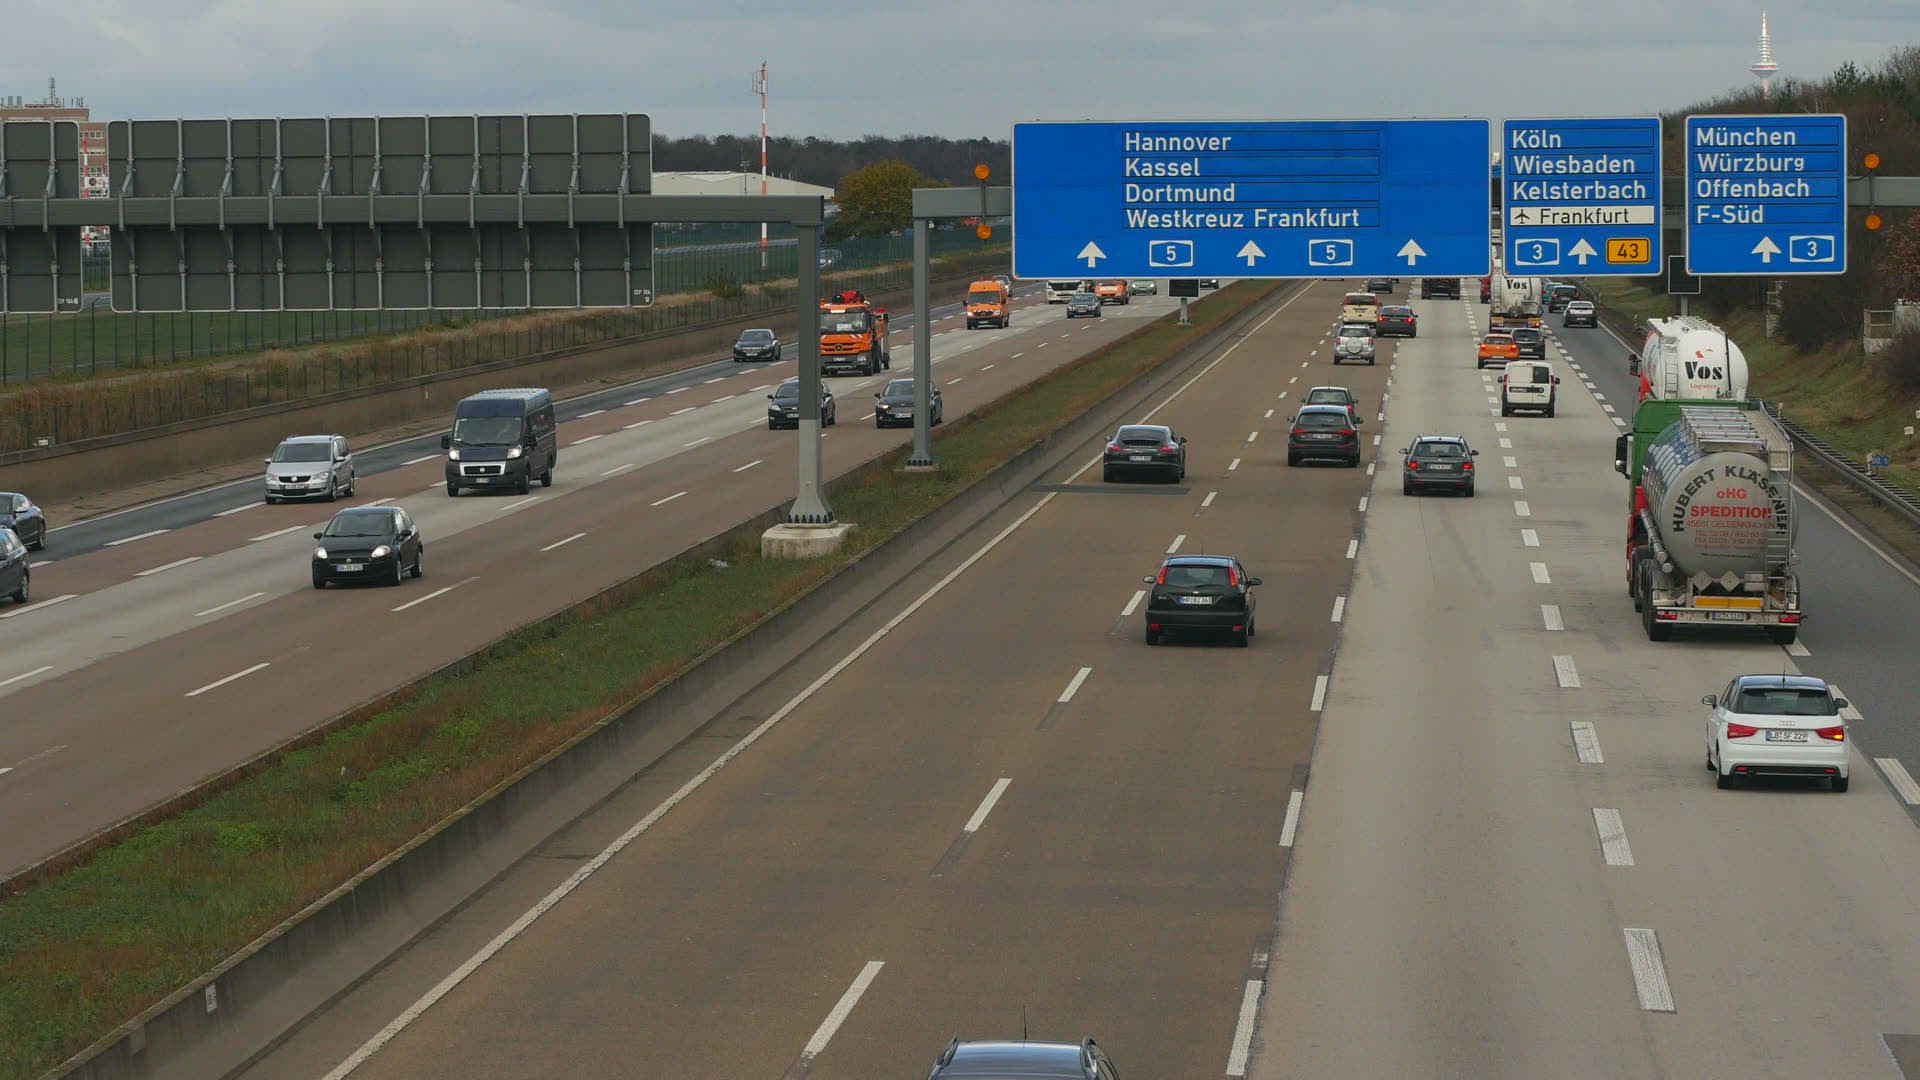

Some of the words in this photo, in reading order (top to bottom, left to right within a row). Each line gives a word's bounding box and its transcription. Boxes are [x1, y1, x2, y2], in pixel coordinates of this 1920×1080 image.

[1125, 132, 1232, 152] Hannover
[1512, 129, 1562, 149] Köln
[1696, 127, 1797, 146] München
[1125, 157, 1201, 177] Kassel
[1513, 154, 1636, 174] Wiesbaden
[1697, 152, 1806, 173] Würzburg
[1126, 182, 1236, 203] Dortmund
[1512, 180, 1647, 201] Kelsterbach
[1696, 178, 1811, 198] Offenbach
[1126, 208, 1244, 229] Westkreuz
[1253, 207, 1360, 228] Frankfurt
[1540, 207, 1631, 225] Frankfurt
[1696, 204, 1765, 224] F-Süd
[1166, 245, 1177, 262] 5
[1326, 244, 1336, 261] 5
[1532, 243, 1543, 260] 3
[1617, 243, 1639, 259] 43
[1807, 240, 1818, 257] 3
[1506, 279, 1528, 290] Vos
[1684, 361, 1723, 380] Vos
[1673, 468, 1715, 533] HUBERT
[1716, 487, 1748, 500] oHG
[1690, 505, 1773, 519] SPEDITION
